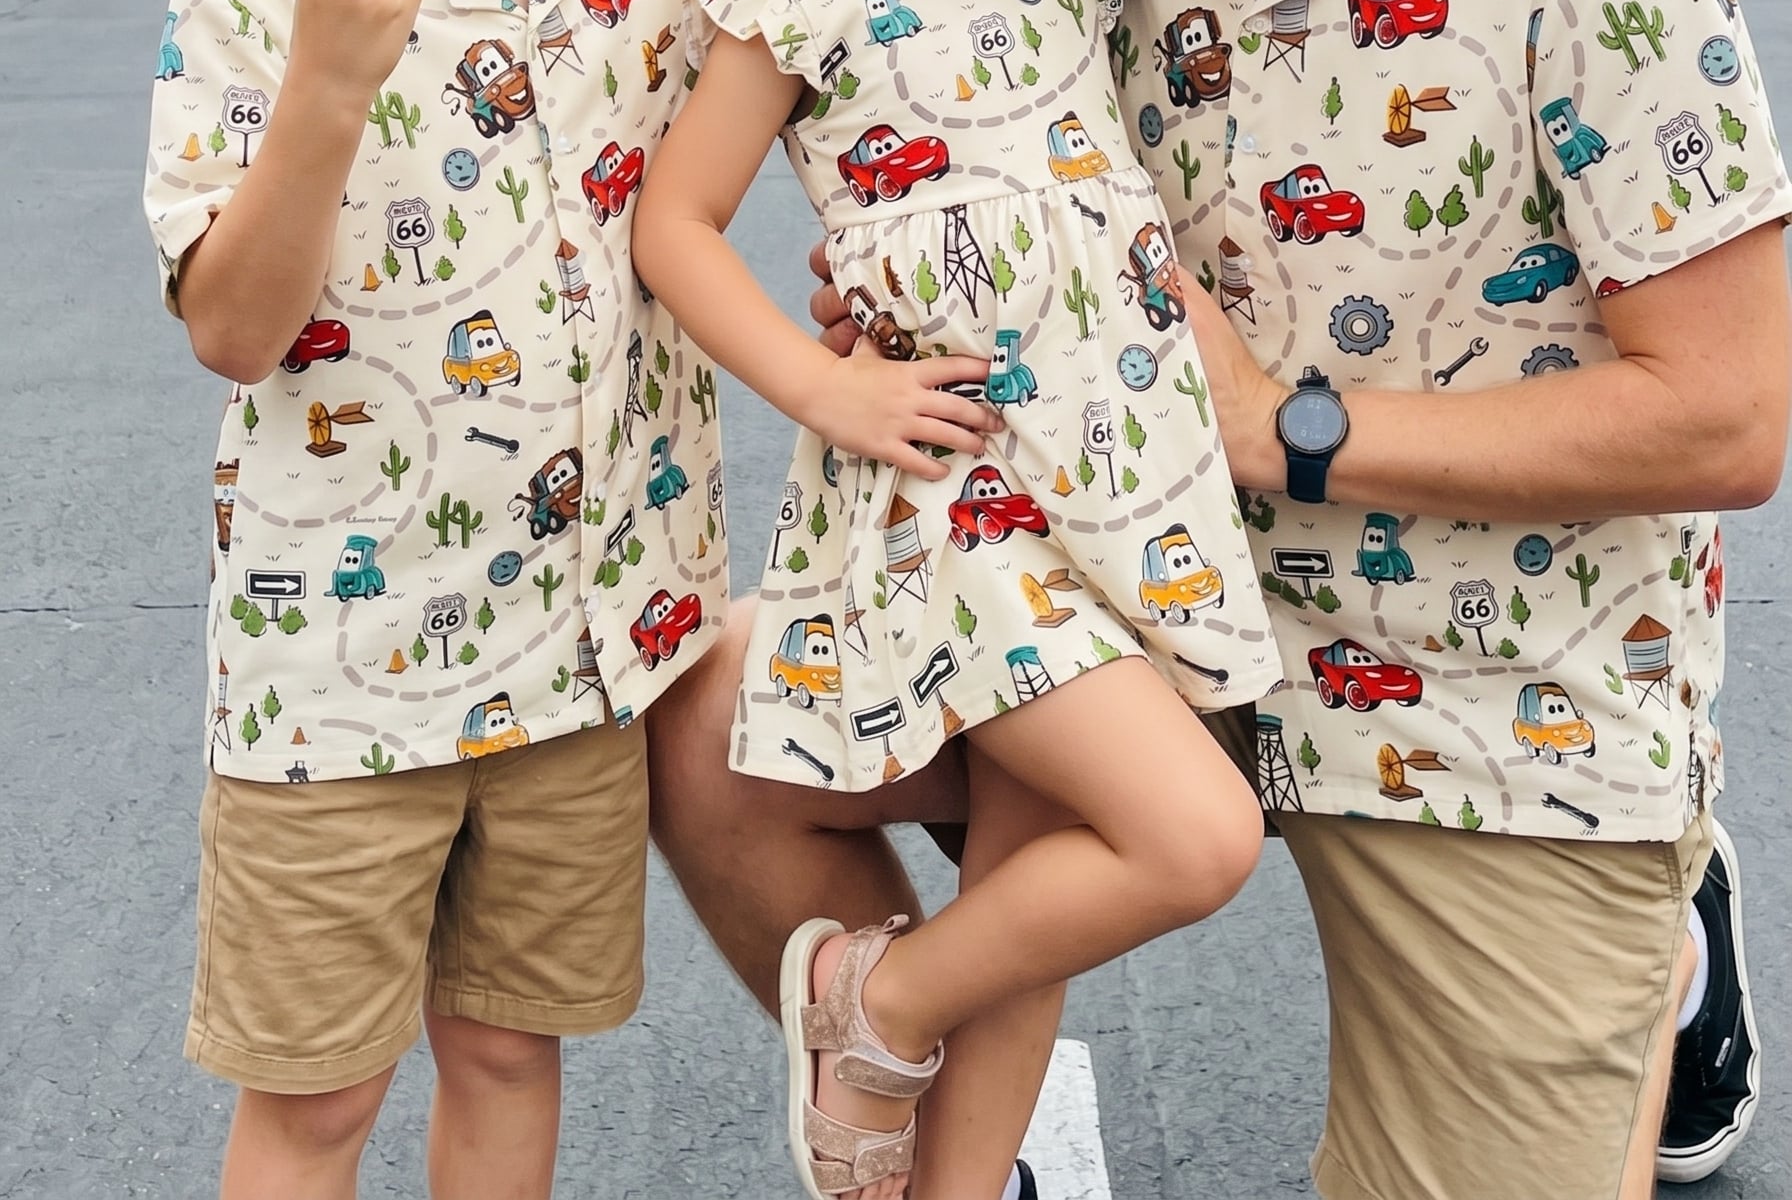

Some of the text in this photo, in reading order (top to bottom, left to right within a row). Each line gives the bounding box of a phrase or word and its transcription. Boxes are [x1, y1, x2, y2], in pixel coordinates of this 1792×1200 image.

[981, 29, 1007, 51] 66
[231, 104, 262, 125] 66
[1672, 131, 1704, 165] 66
[396, 217, 427, 241] 66
[430, 609, 459, 630] 66
[1461, 598, 1490, 620] 66
